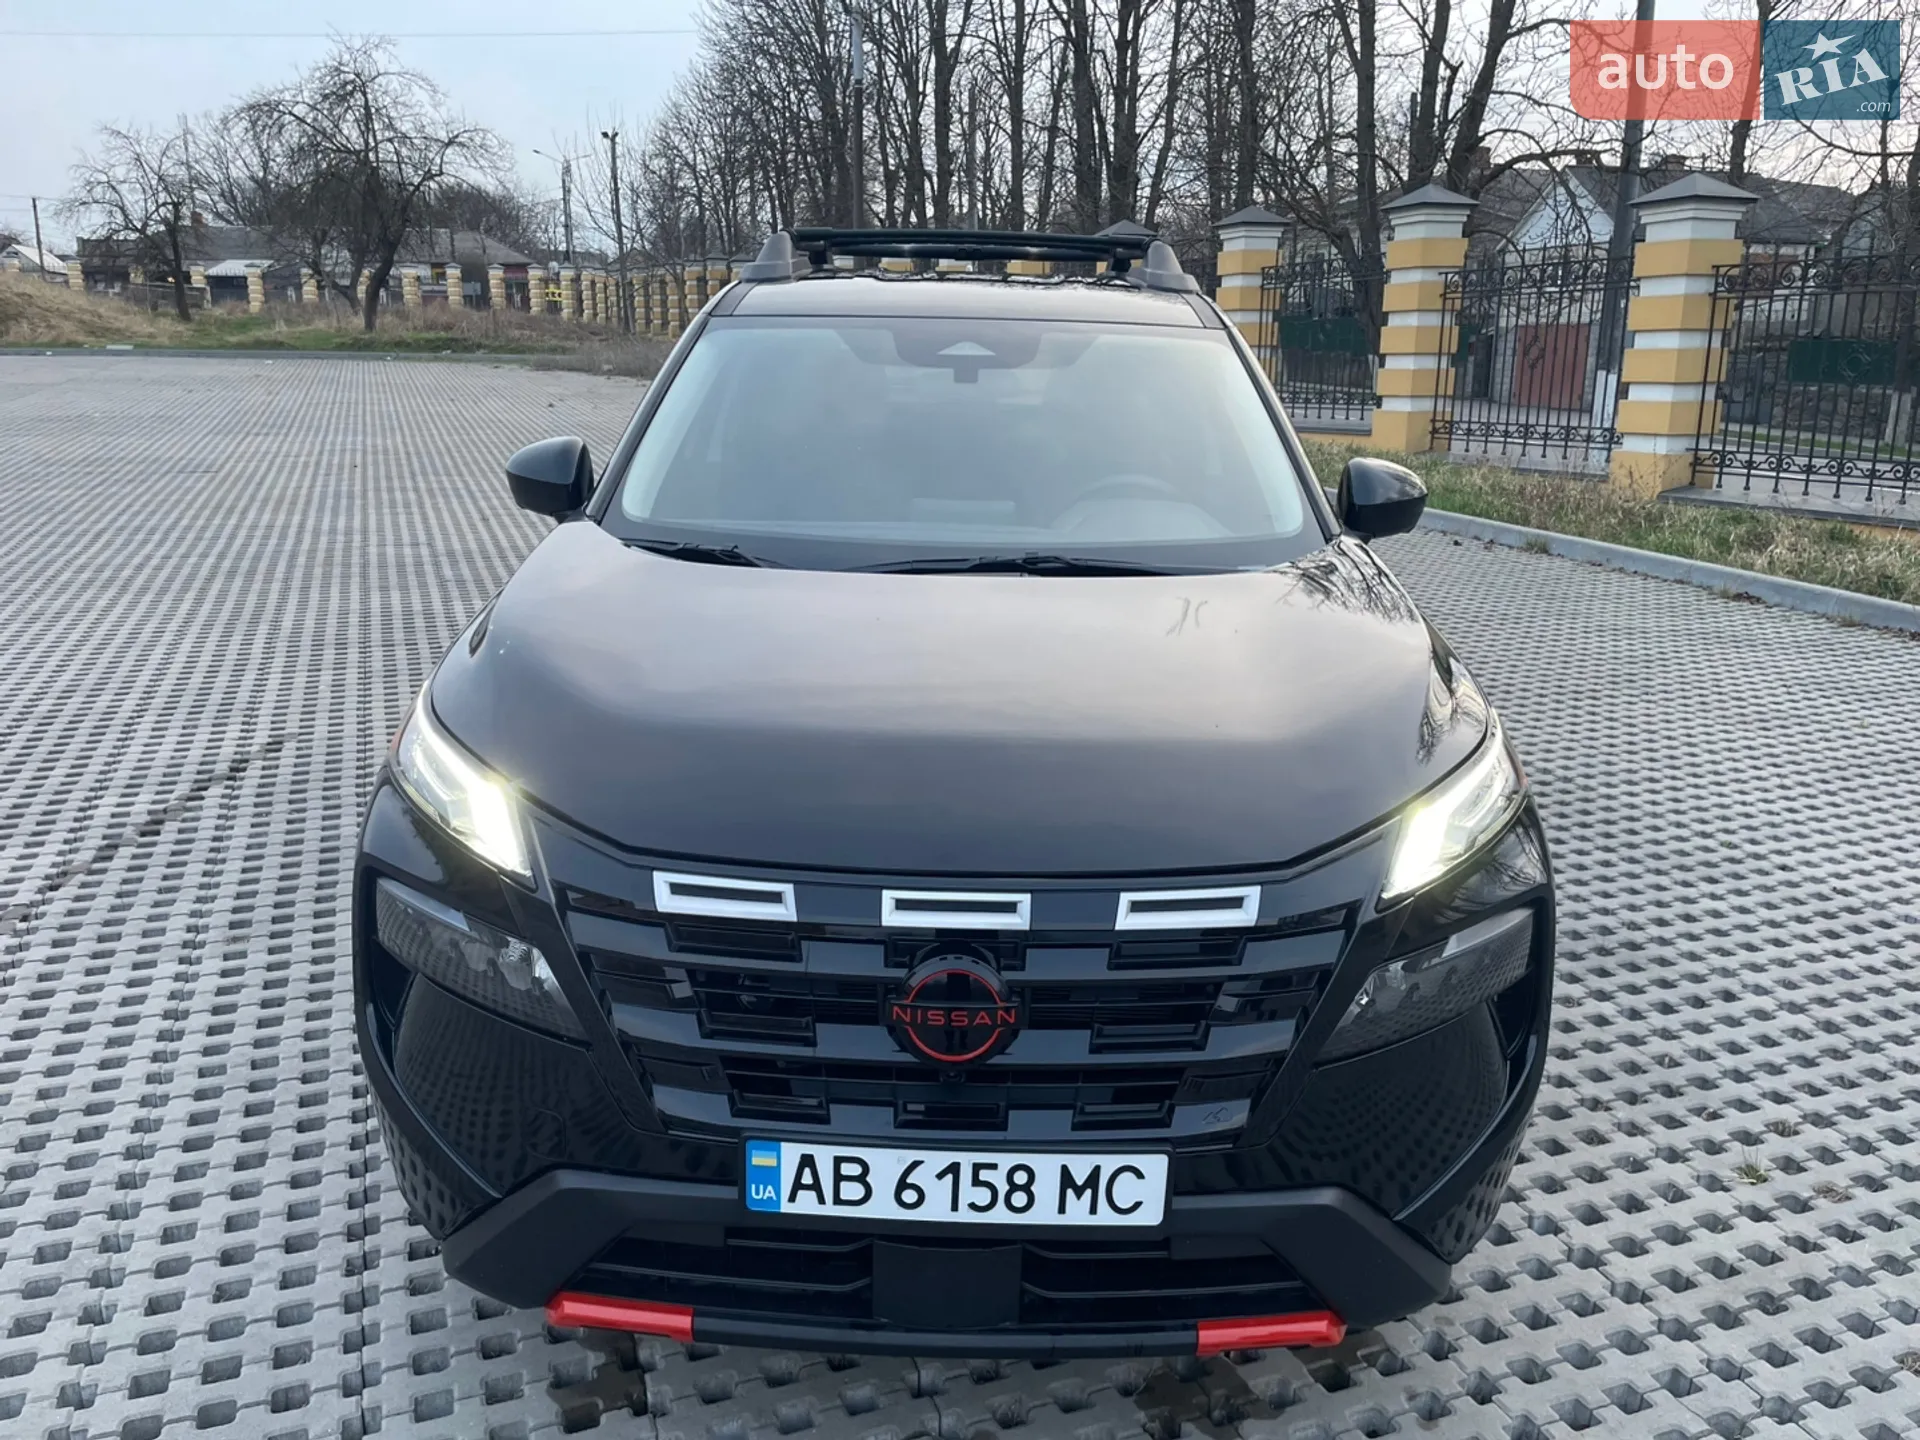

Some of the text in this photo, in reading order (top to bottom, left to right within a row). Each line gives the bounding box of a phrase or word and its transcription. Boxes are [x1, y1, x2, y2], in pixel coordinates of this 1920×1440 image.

[892, 1005, 1016, 1027] NISSAN
[751, 1185, 777, 1201] UA
[787, 1153, 1146, 1216] AB 6158 MC
